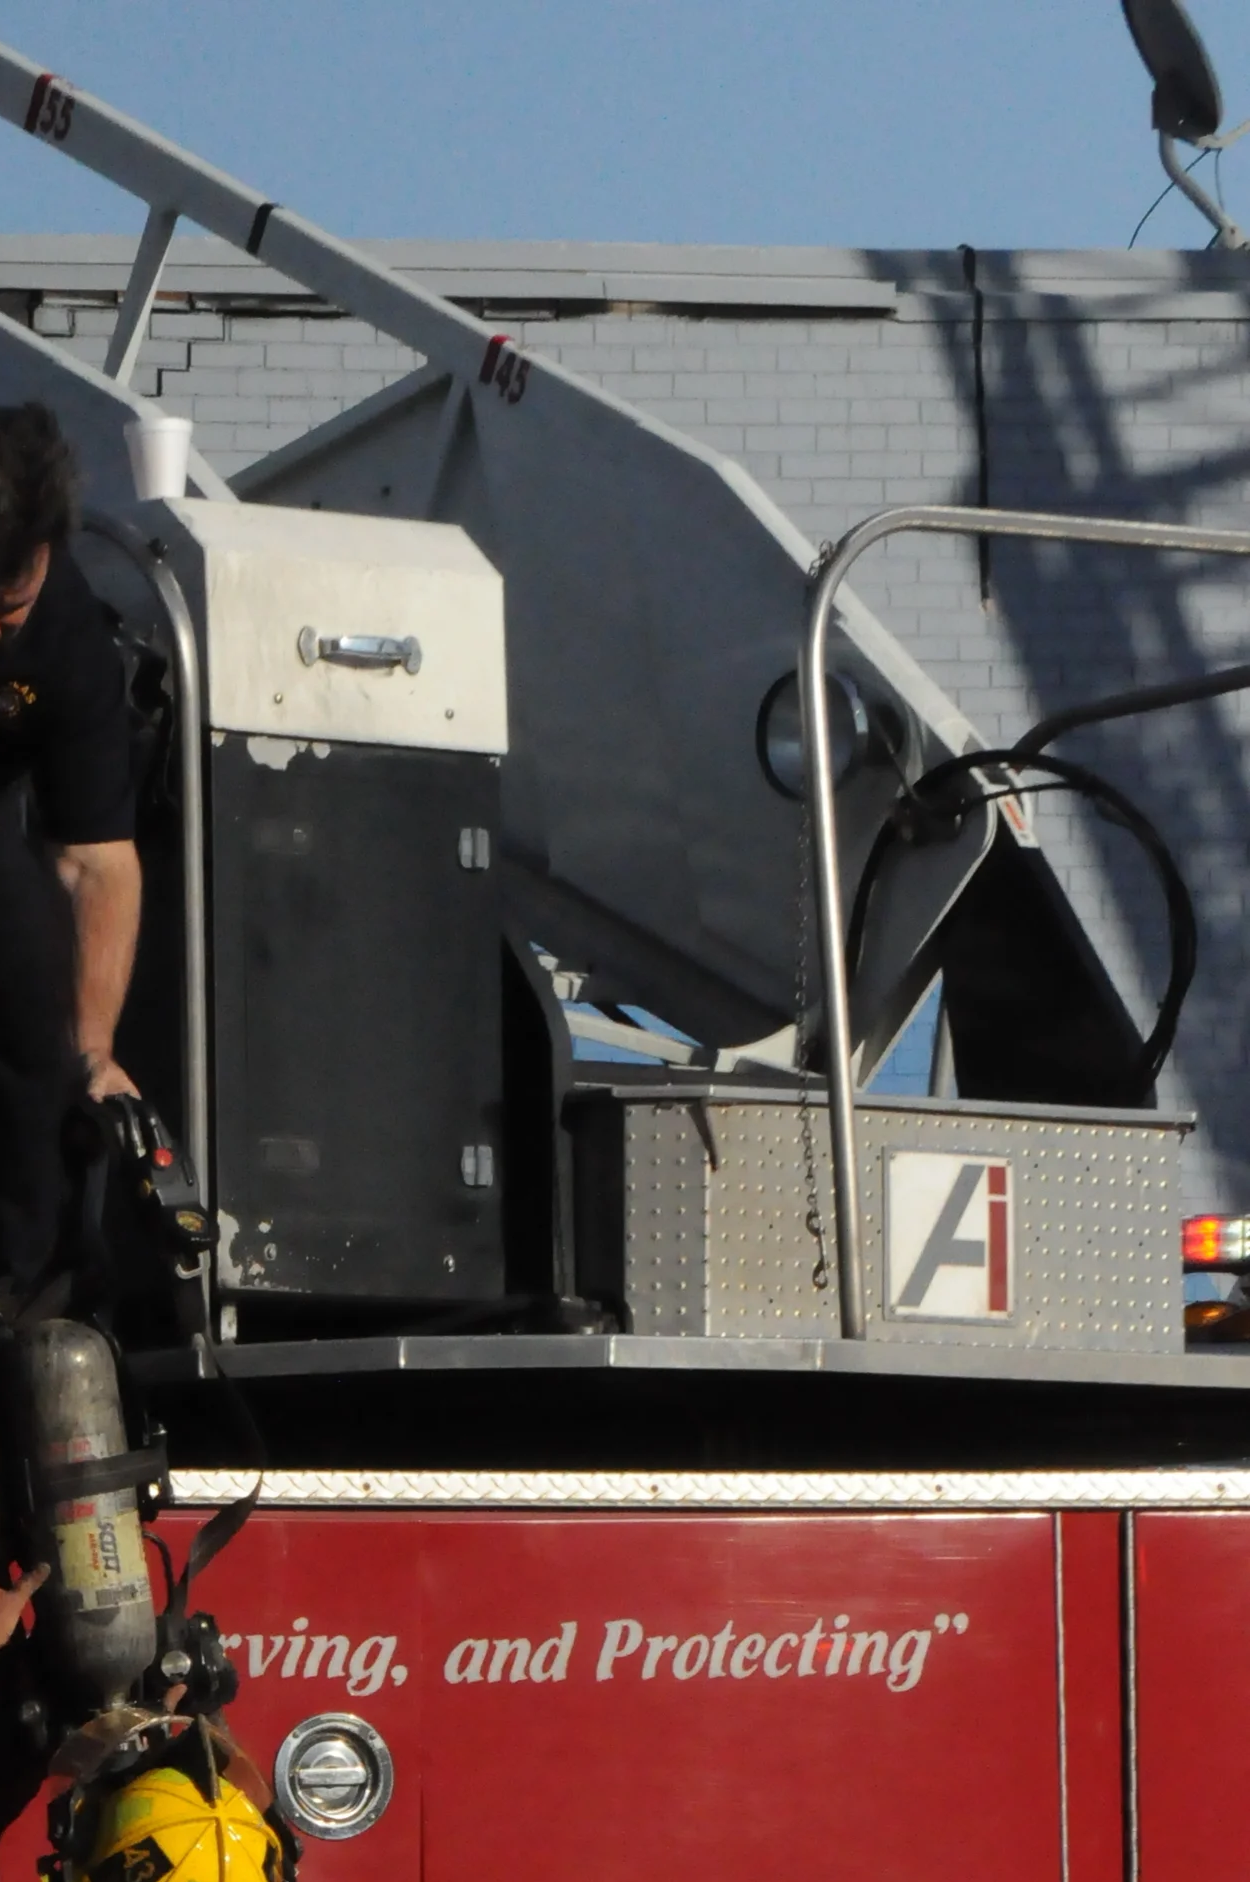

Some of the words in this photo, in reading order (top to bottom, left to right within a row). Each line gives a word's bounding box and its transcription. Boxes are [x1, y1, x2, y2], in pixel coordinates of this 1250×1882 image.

[40, 87, 75, 141] 55
[494, 351, 530, 405] 45
[444, 1621, 578, 1684] and
